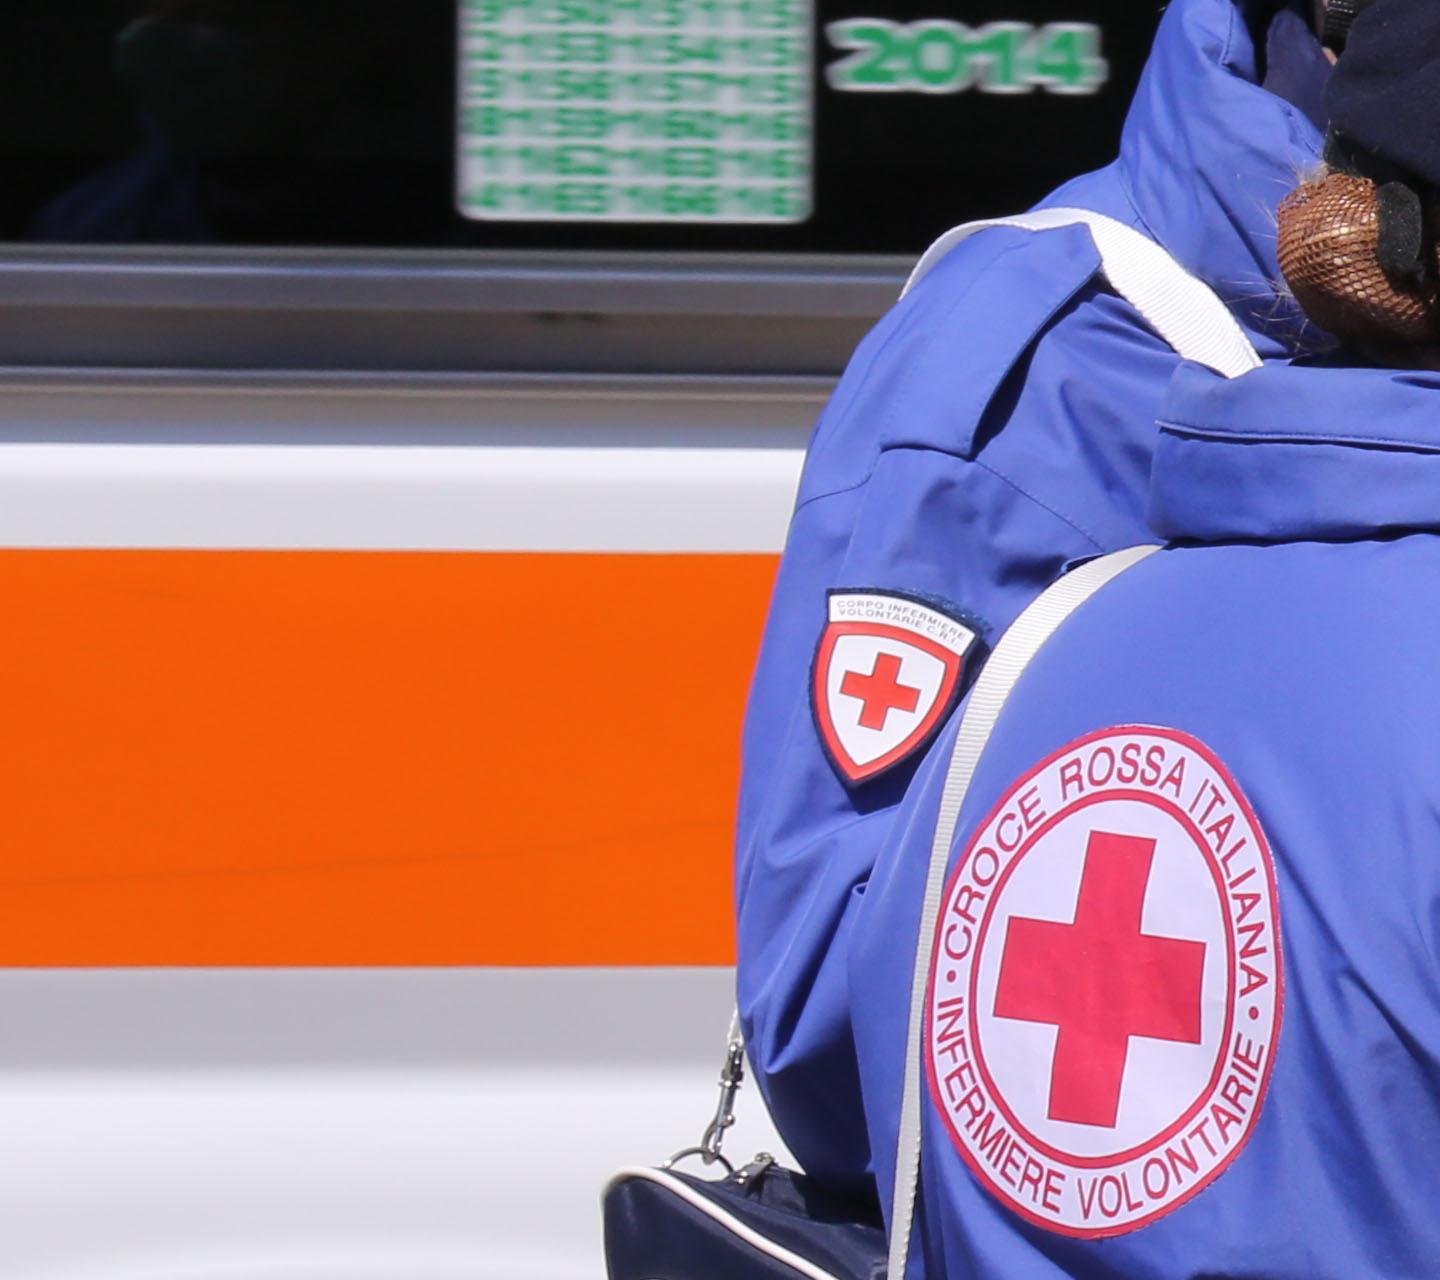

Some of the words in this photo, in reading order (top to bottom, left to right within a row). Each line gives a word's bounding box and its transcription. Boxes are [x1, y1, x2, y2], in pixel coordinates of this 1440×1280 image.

[835, 22, 1098, 92] 2014
[836, 600, 885, 610] CORPO
[888, 603, 966, 640] INFERMIERE
[838, 608, 923, 628] VOLONTARIE
[944, 785, 1047, 961] CROCE
[1058, 742, 1187, 802] ROSSA
[1188, 778, 1269, 997] ITALIANA
[936, 998, 1068, 1215] INFERMIERE
[1076, 1031, 1267, 1220] VOLONTARIE
